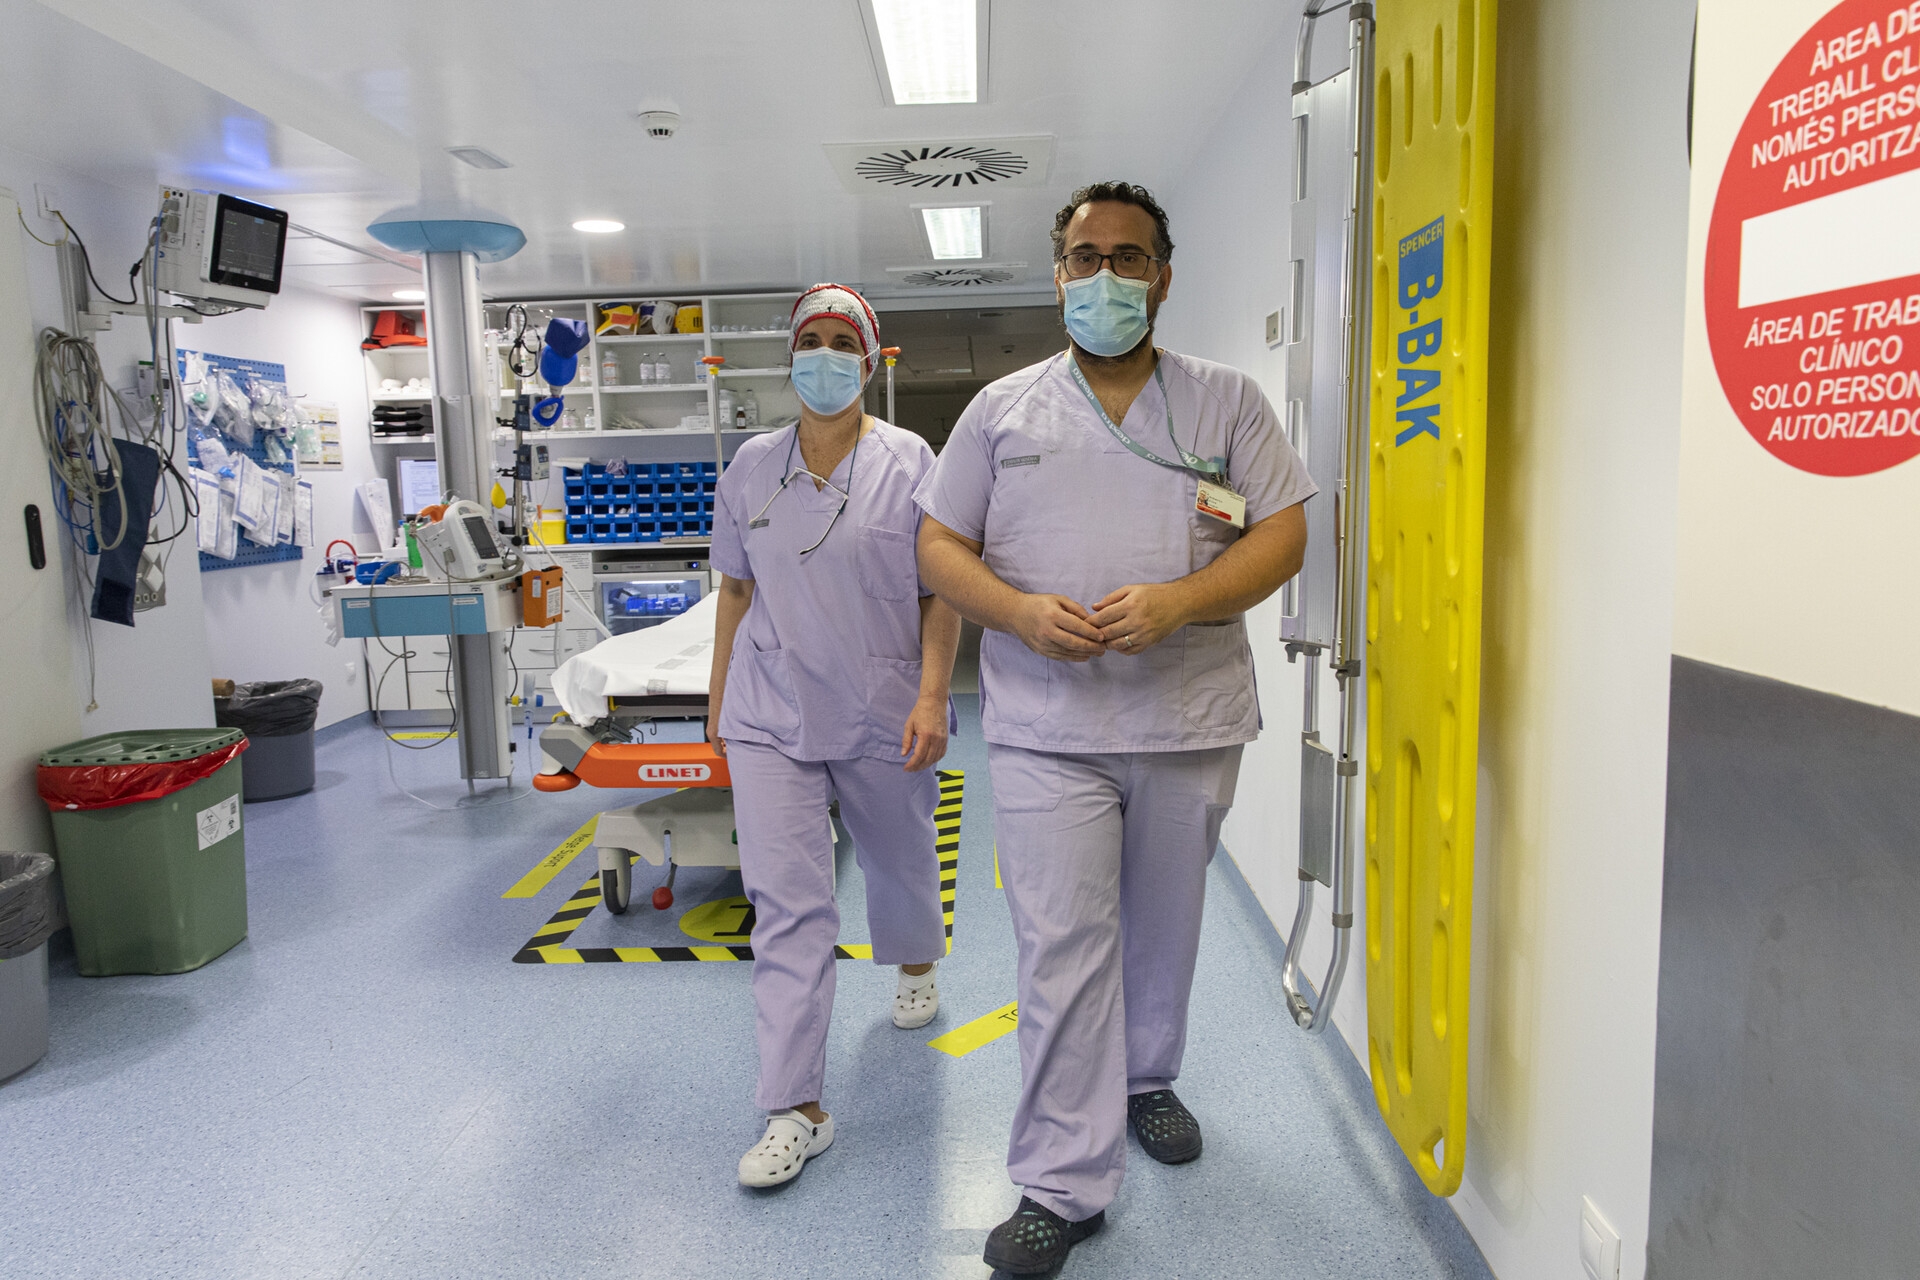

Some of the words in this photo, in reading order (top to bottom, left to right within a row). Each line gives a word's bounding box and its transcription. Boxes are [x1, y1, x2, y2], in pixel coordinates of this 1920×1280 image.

[1768, 63, 1876, 127] TREBALL
[1881, 45, 1920, 82] CL
[1751, 115, 1835, 169] NOMÉS
[1841, 84, 1920, 137] PERS
[1400, 221, 1444, 259] SPENCER
[1744, 317, 1804, 349] ÁREA
[1808, 307, 1846, 339] DE
[1395, 262, 1444, 449] B-BAK
[1799, 336, 1904, 374] CLÍNICO
[1072, 367, 1095, 400] dextro
[1750, 381, 1812, 411] SOLO
[1101, 412, 1131, 444] dextro
[646, 767, 704, 778] LINET
